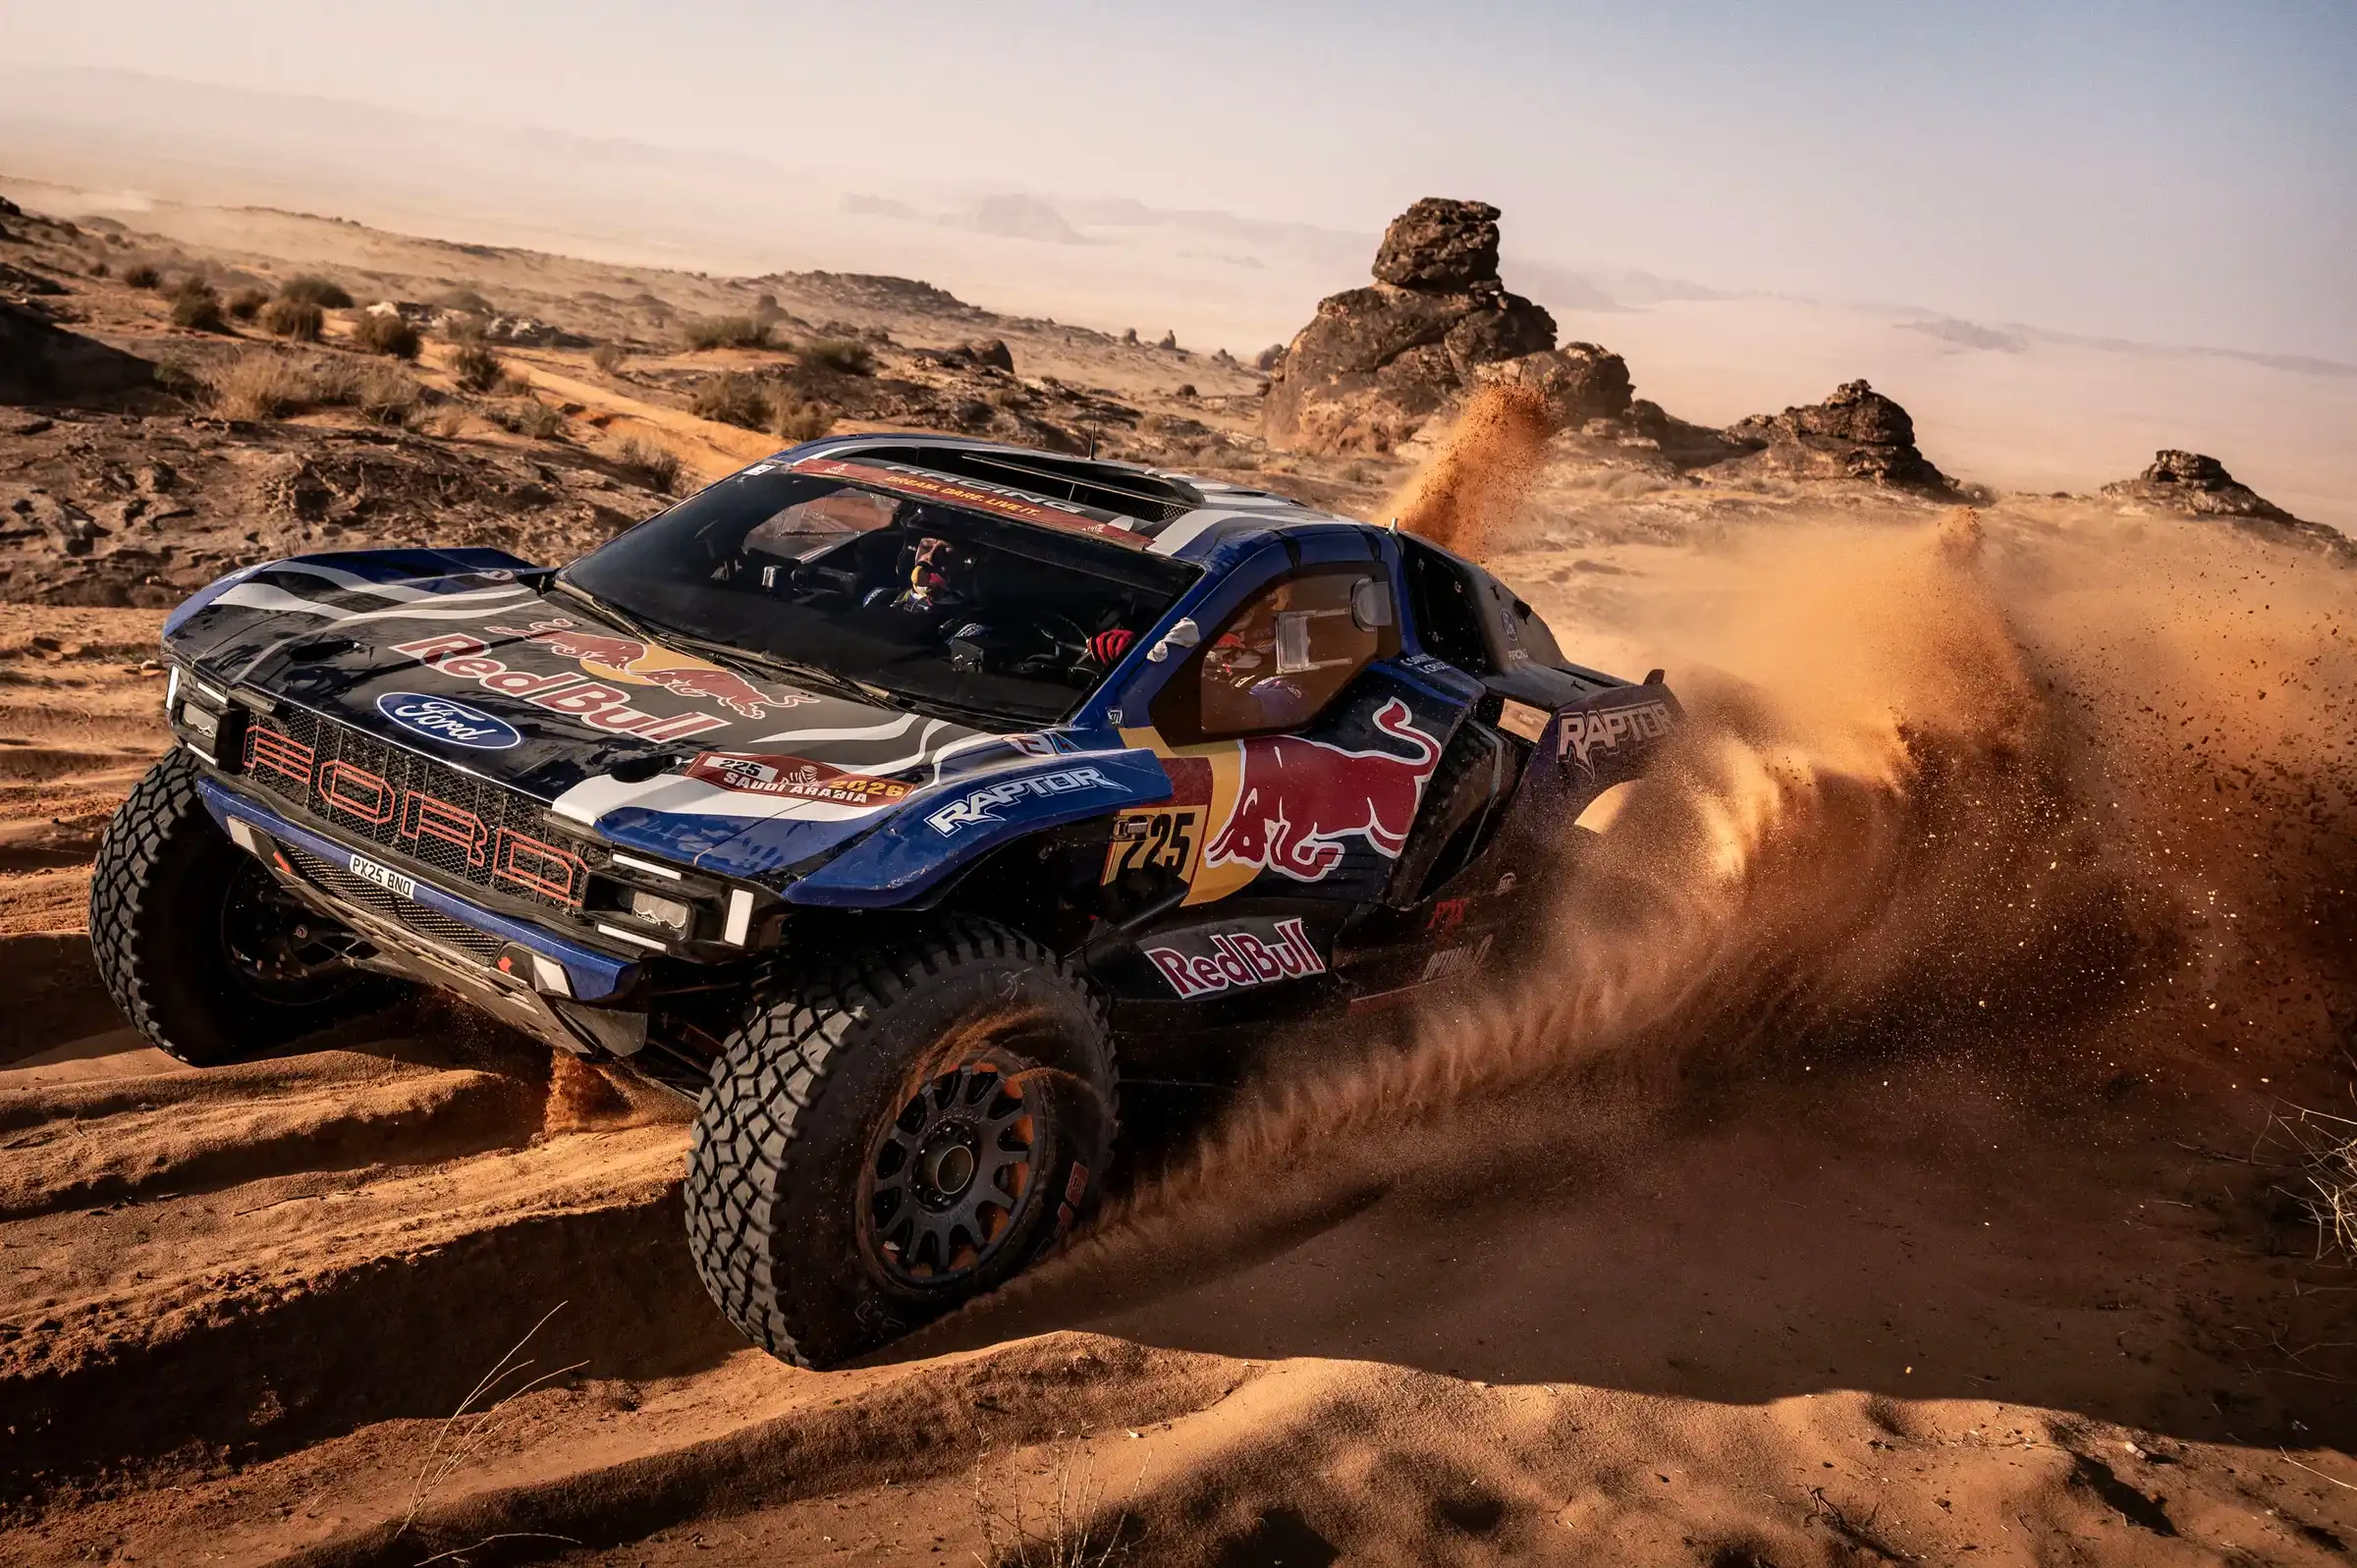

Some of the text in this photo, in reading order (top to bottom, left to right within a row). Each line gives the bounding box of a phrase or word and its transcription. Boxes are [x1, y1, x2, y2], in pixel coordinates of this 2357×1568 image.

[885, 465, 1086, 514] RACING
[984, 498, 1022, 512] LIVE
[395, 700, 498, 741] Ford
[1557, 699, 1676, 784] RAPTOR
[719, 760, 762, 777] 225
[723, 772, 786, 792] SAUDI
[789, 785, 868, 803] ARABIA
[828, 780, 904, 797] 2026
[923, 767, 1132, 838] RAPTOR
[243, 725, 591, 909] FORD
[353, 857, 384, 884] PX25
